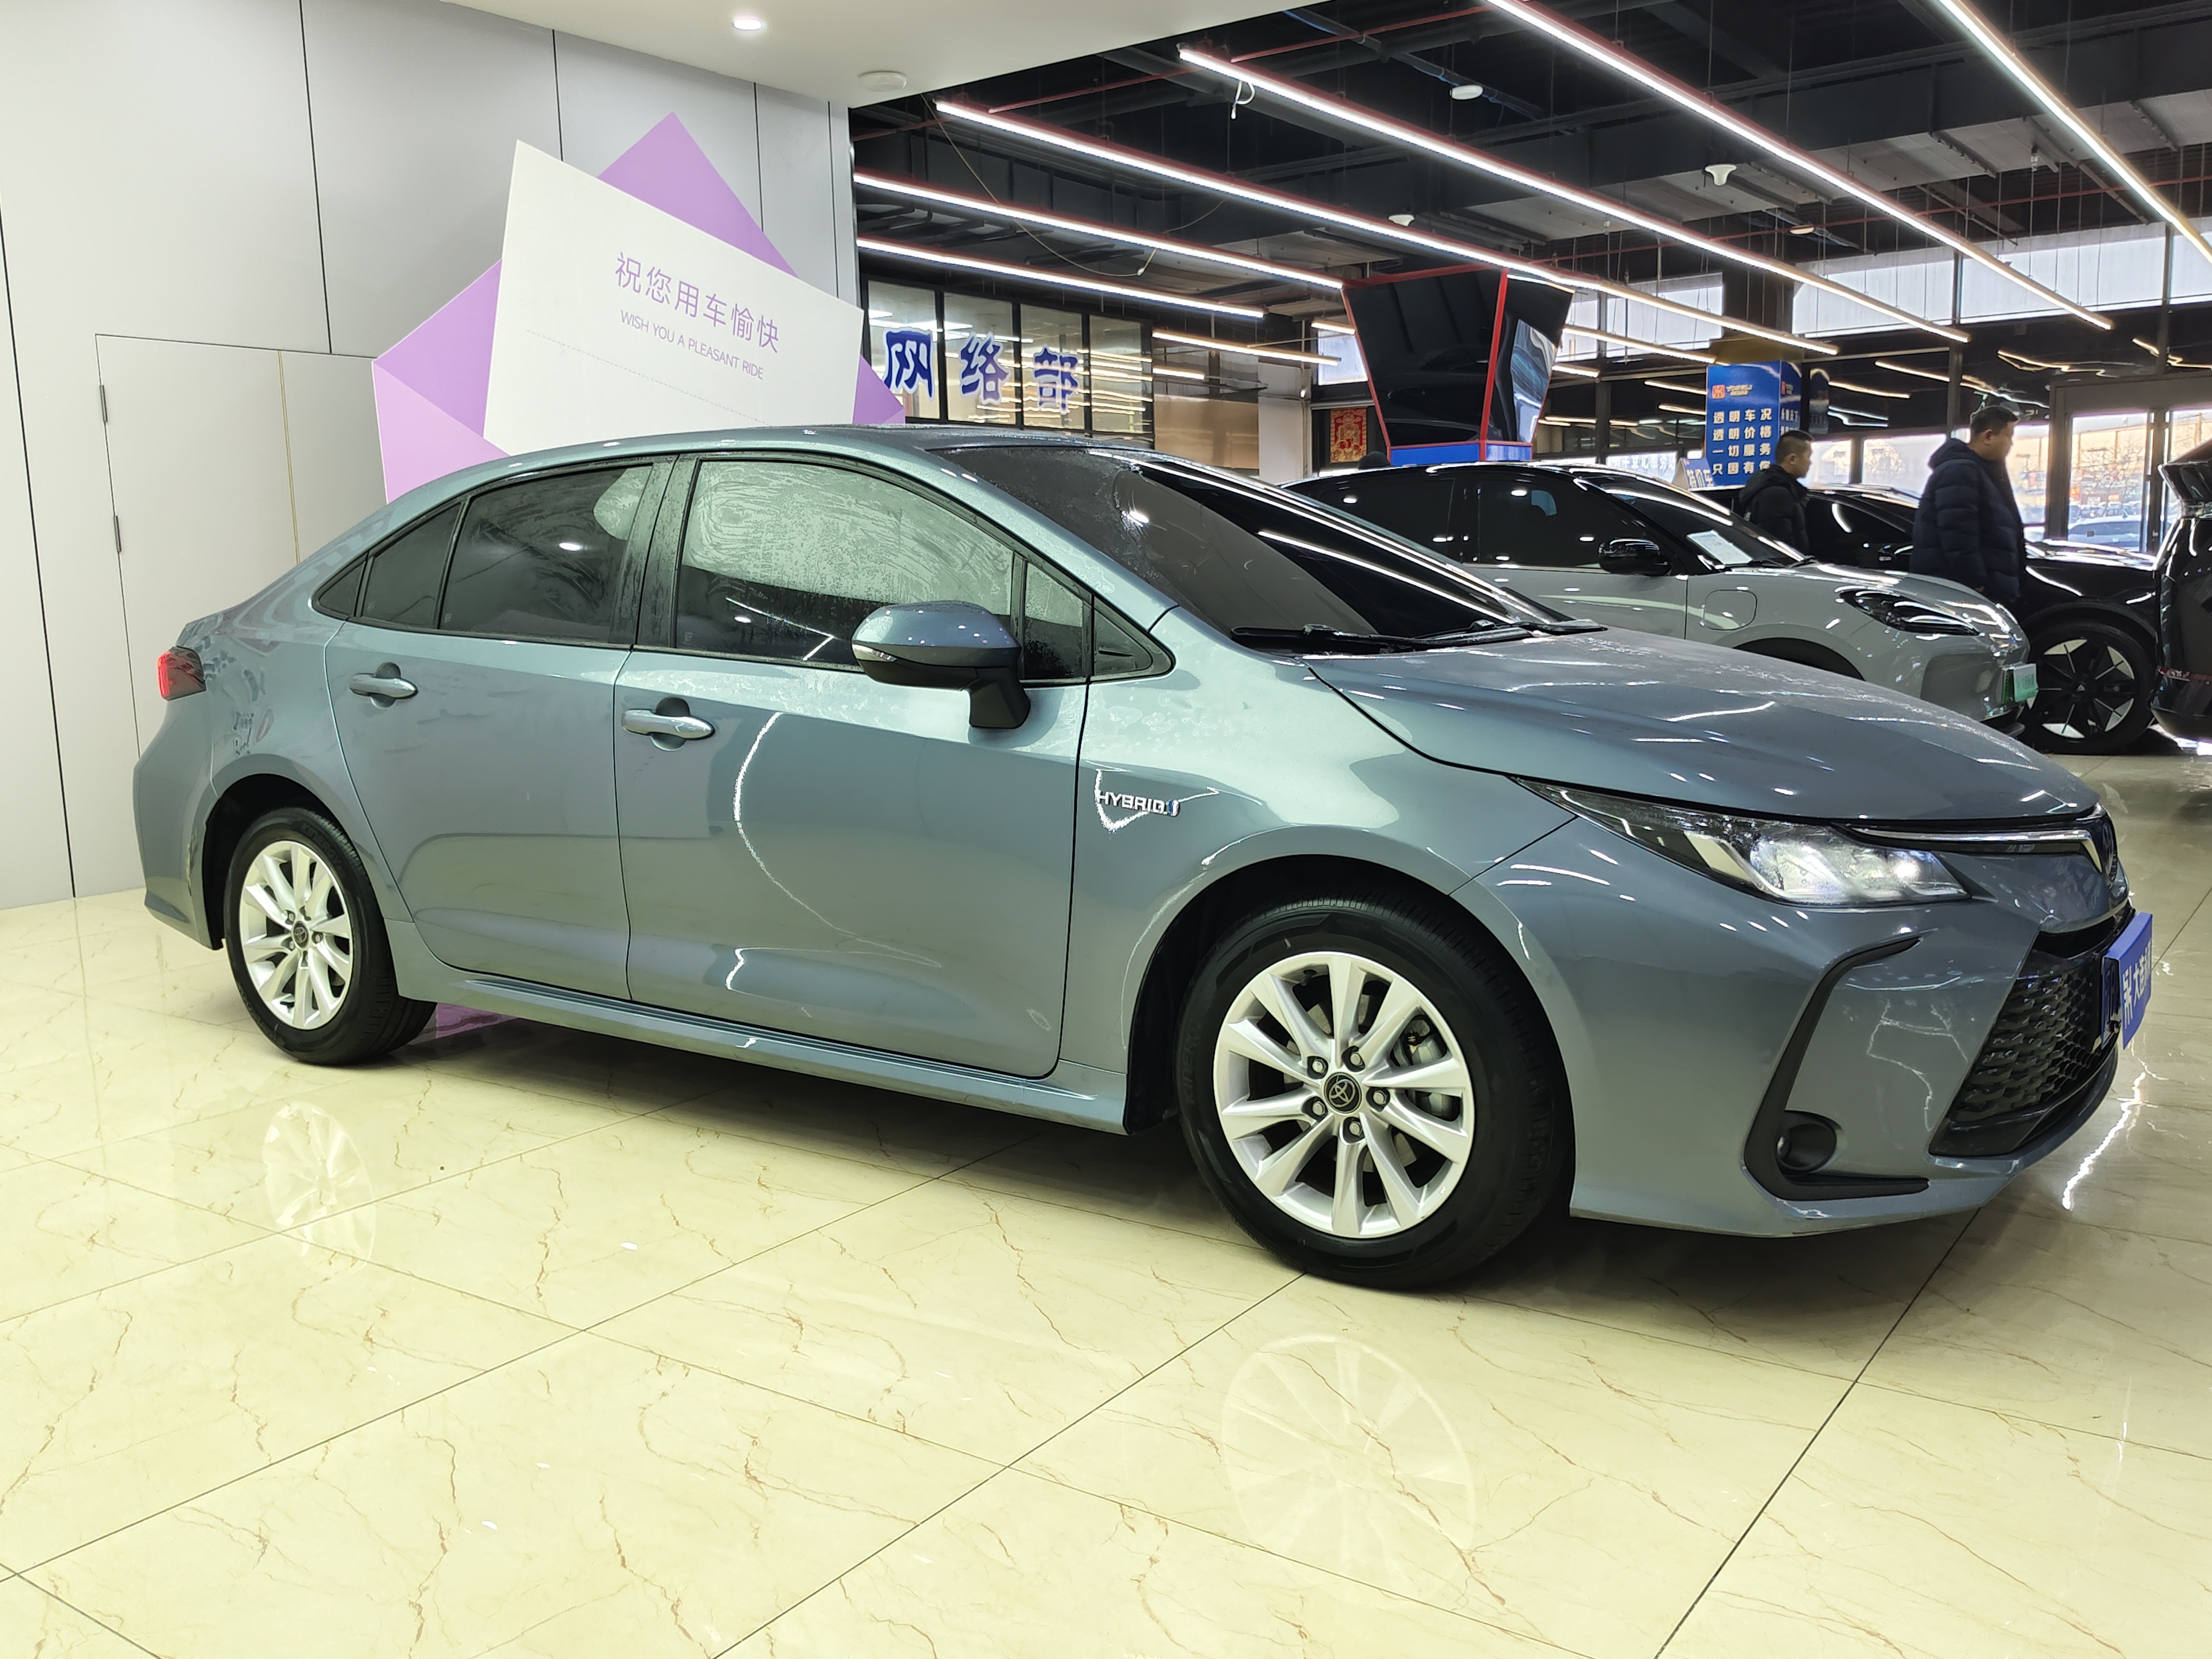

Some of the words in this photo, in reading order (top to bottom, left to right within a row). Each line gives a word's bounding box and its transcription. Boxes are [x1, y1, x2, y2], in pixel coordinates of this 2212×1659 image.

[615, 252, 780, 353] 祝您用车愉快
[620, 309, 649, 331] WISH
[653, 323, 675, 343] YOU
[678, 335, 686, 348] A
[689, 339, 741, 369] PLEASANT
[742, 359, 764, 380] RIDE
[882, 327, 1080, 415] 网络部
[1713, 408, 1772, 424] 透明车况
[1712, 426, 1772, 441] 透明价格
[1712, 443, 1771, 457] 一切服务
[1096, 791, 1165, 814] HYBRID
